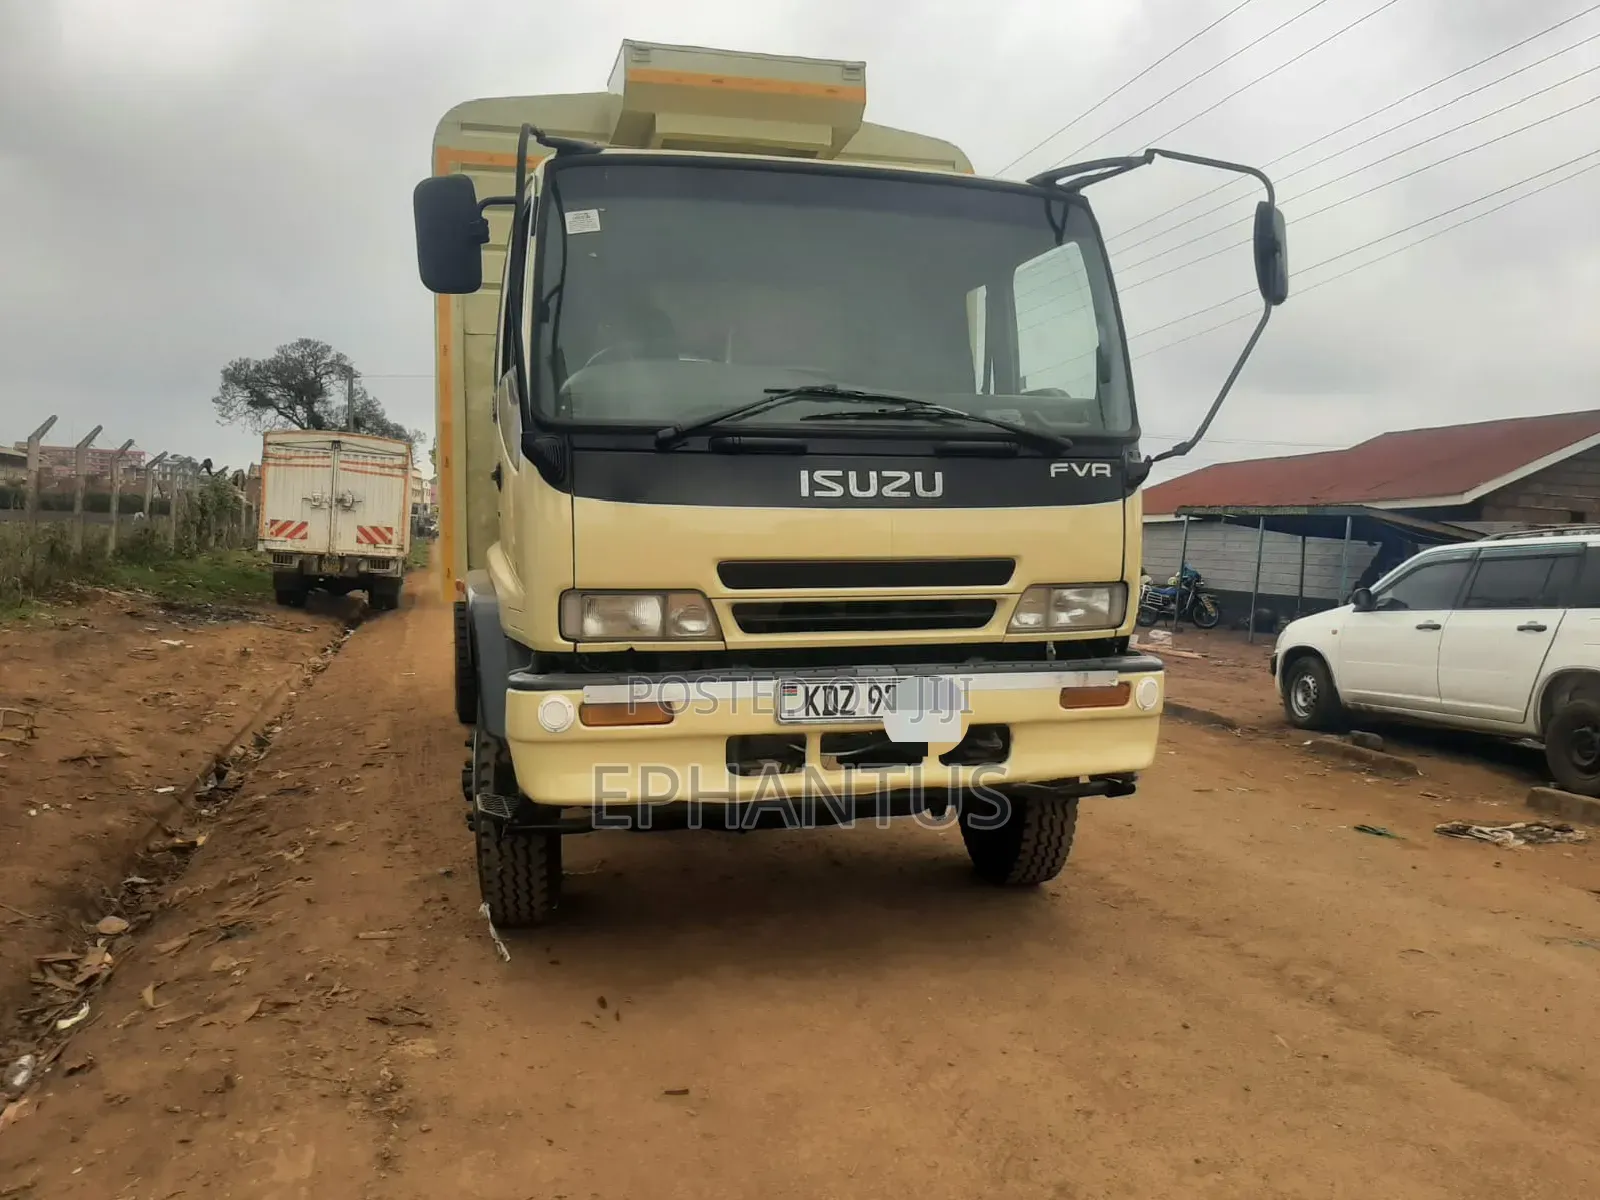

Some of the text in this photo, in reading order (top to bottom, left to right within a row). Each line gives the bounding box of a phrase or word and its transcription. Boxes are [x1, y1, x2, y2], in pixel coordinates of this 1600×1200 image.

[800, 470, 943, 498] ISUZU
[1049, 462, 1112, 478] FVR
[804, 684, 857, 717] KDZ
